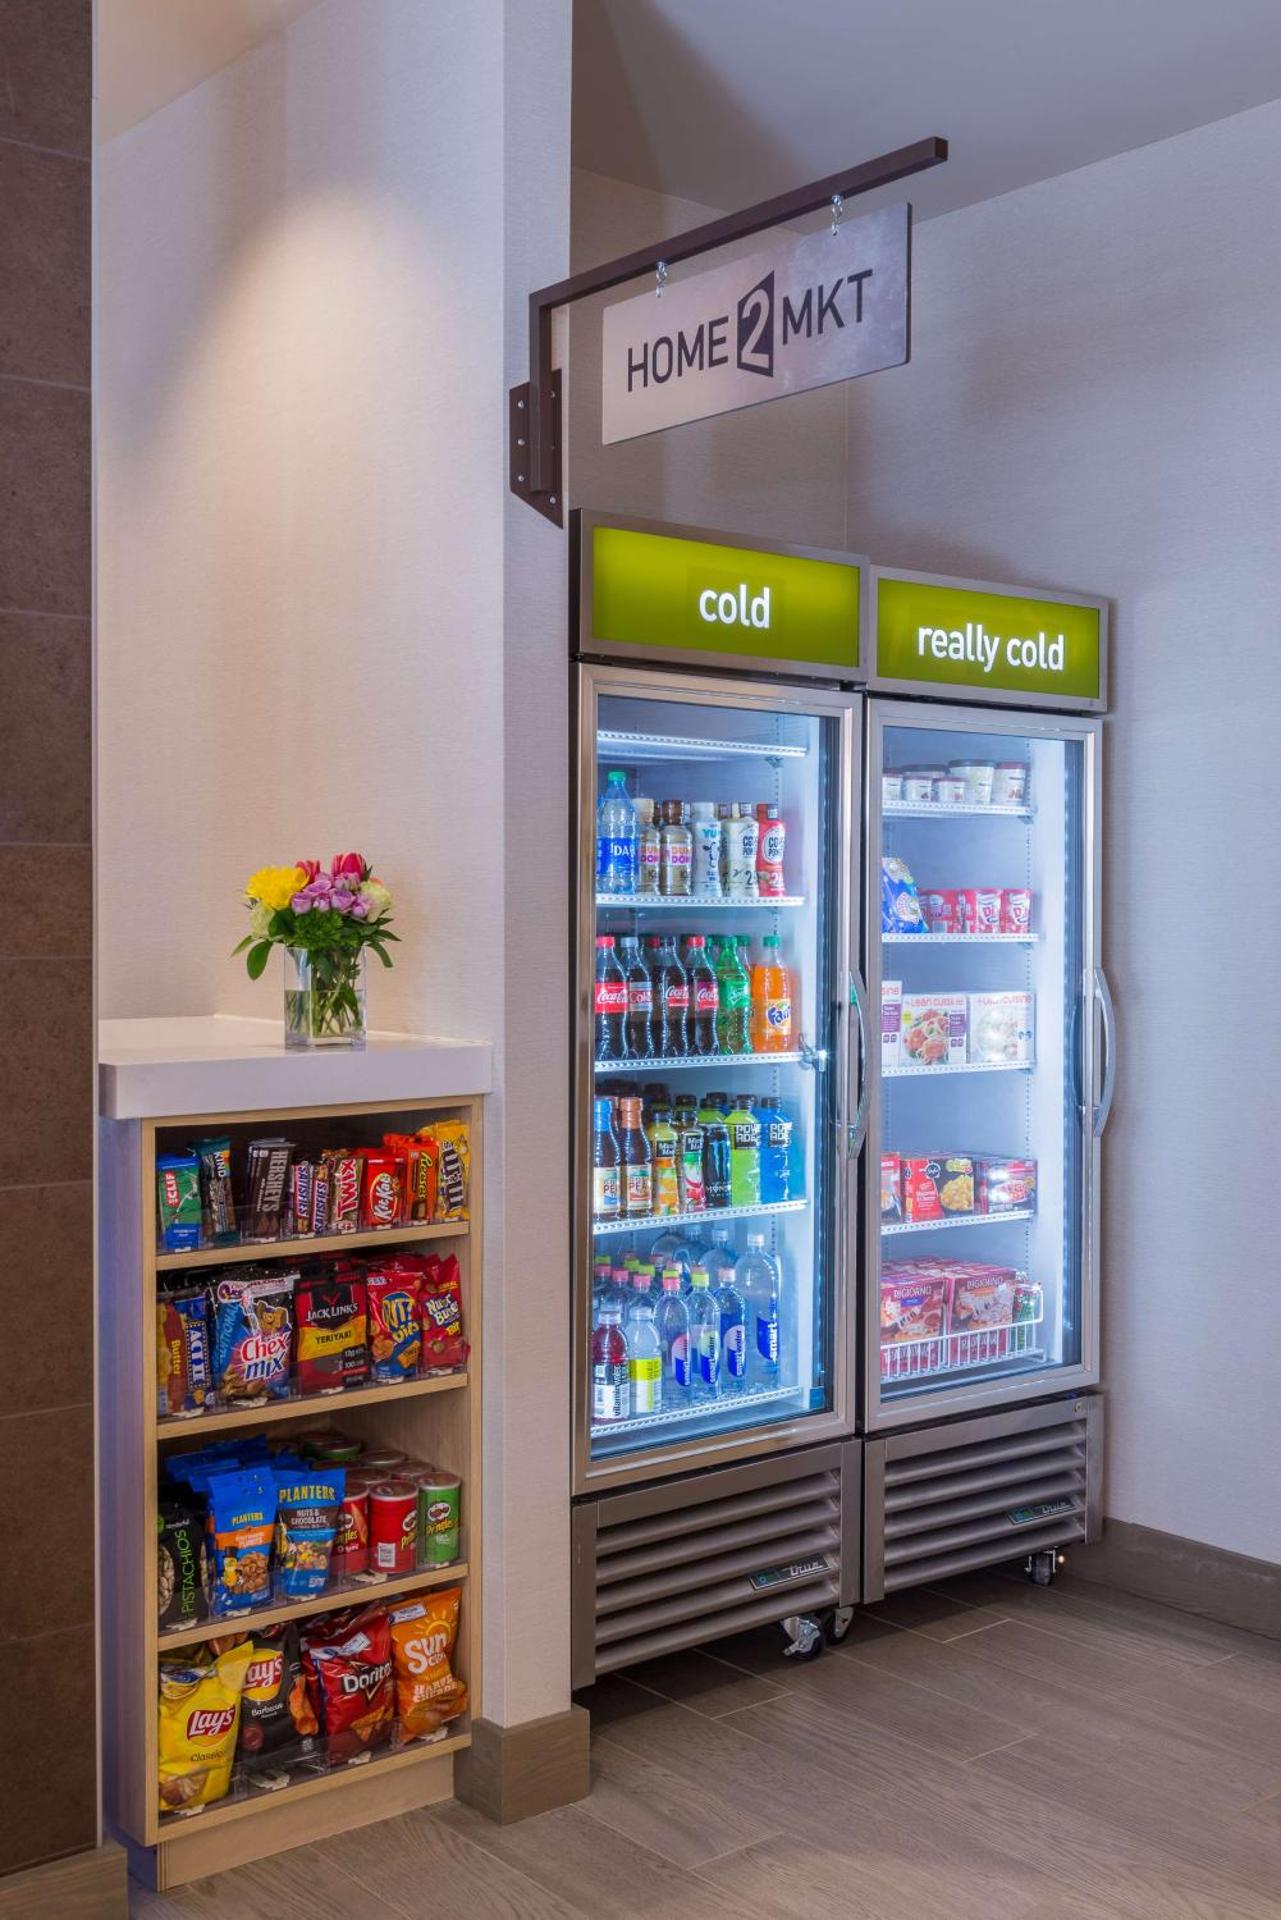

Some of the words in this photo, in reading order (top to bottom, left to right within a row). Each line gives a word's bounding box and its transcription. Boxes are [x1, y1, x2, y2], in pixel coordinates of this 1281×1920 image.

[699, 583, 771, 630] cold
[918, 622, 1000, 673] really
[1005, 630, 1066, 672] cold
[212, 1151, 228, 1178] KIND
[241, 1332, 292, 1363] Chex
[278, 1485, 336, 1503] PLANTERS
[174, 1528, 195, 1614] PISTACHIOS
[404, 1632, 448, 1675] Sun
